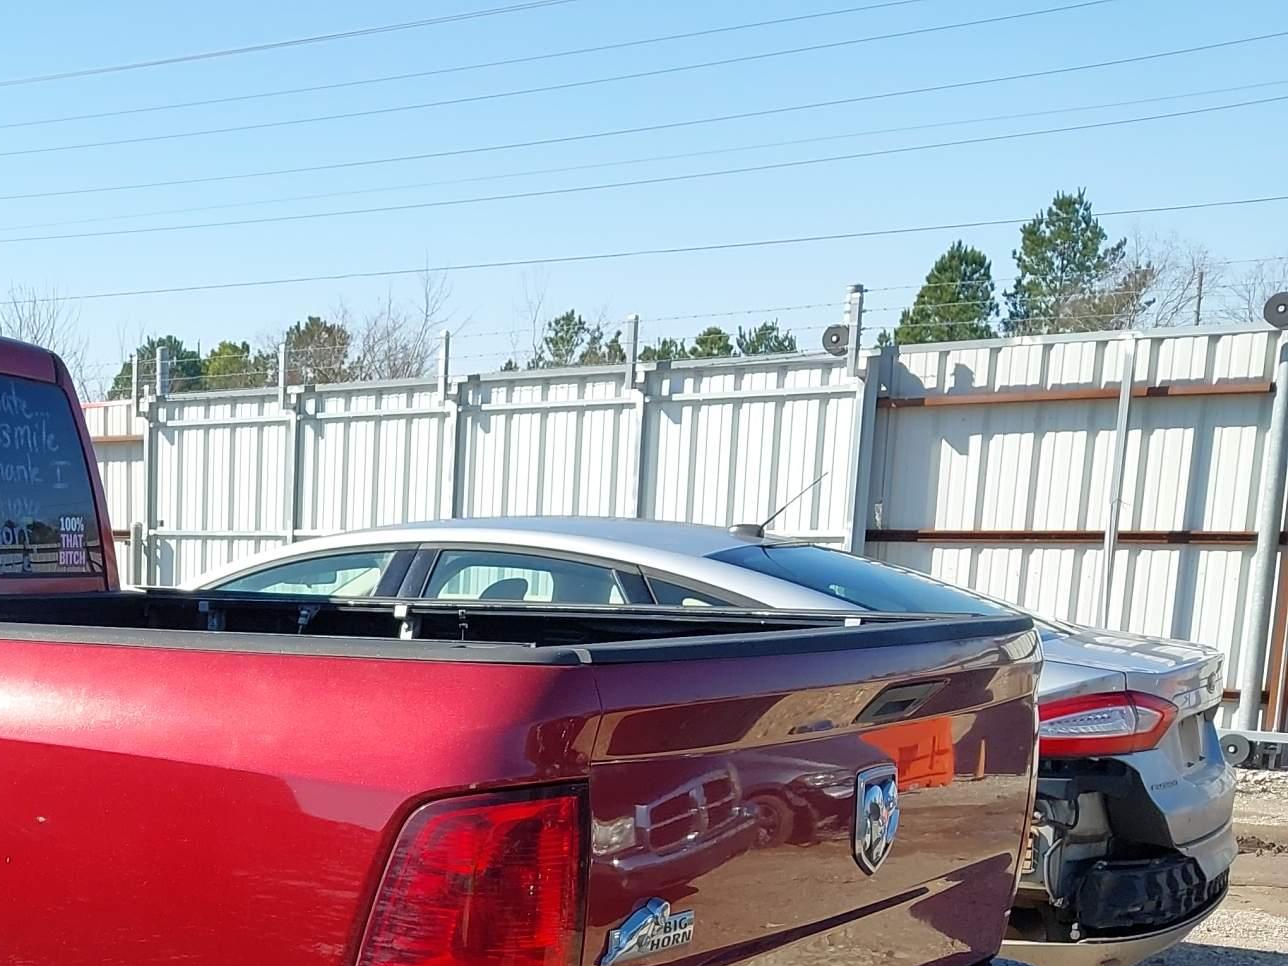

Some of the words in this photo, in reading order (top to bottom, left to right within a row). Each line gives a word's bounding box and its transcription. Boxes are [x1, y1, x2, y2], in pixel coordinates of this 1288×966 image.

[60, 516, 85, 532] 100%
[60, 533, 84, 548] THAT
[59, 550, 86, 565] BITCH
[663, 916, 690, 934] BIG
[650, 929, 693, 952] HORN
